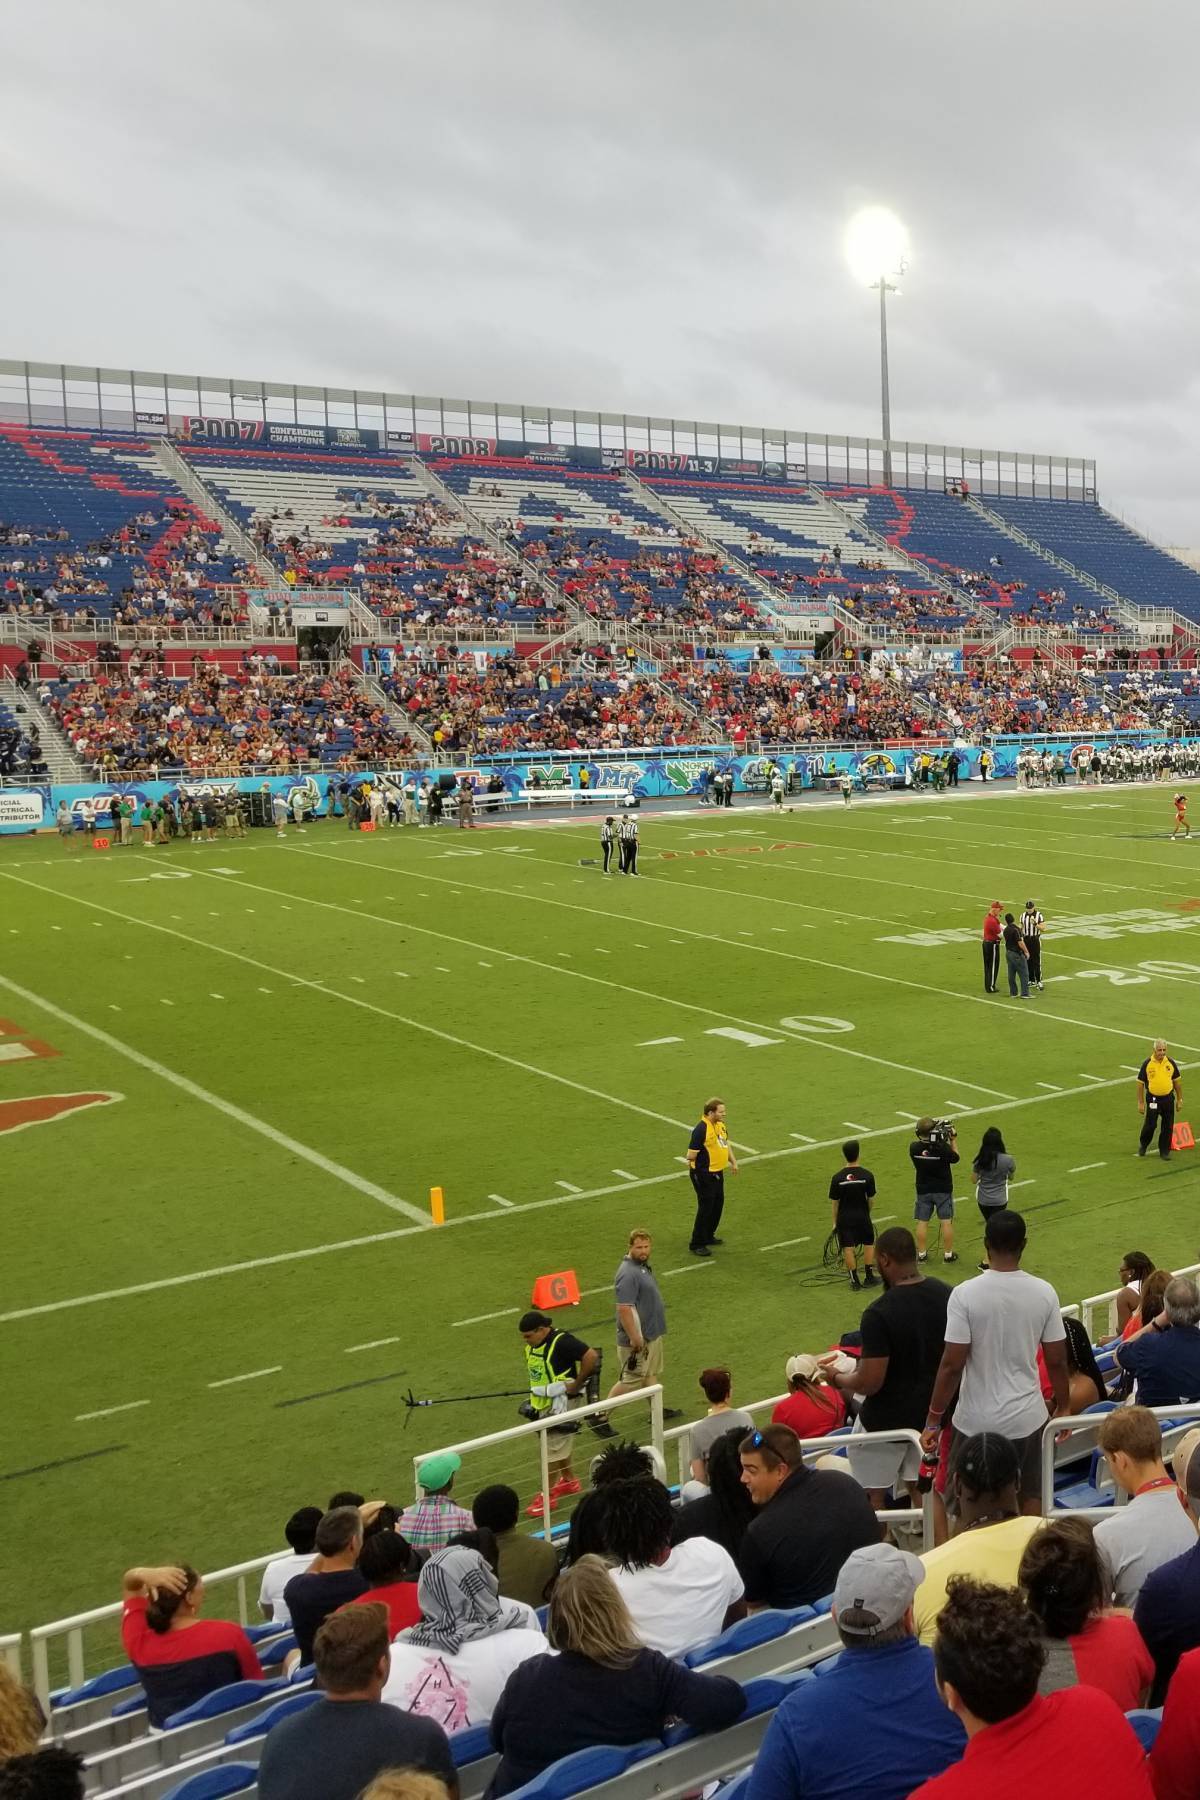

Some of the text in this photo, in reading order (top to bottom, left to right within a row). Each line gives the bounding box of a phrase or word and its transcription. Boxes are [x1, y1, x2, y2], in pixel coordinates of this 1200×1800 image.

[189, 417, 260, 440] 2007
[270, 426, 325, 438] CONFERENCE
[270, 434, 325, 446] CHAMPIONS
[429, 435, 490, 456] 2008
[687, 458, 713, 474] 11-3
[682, 760, 714, 771] NORTH
[703, 1015, 856, 1048] 10
[1173, 1125, 1191, 1146] 10
[550, 1276, 569, 1302] G
